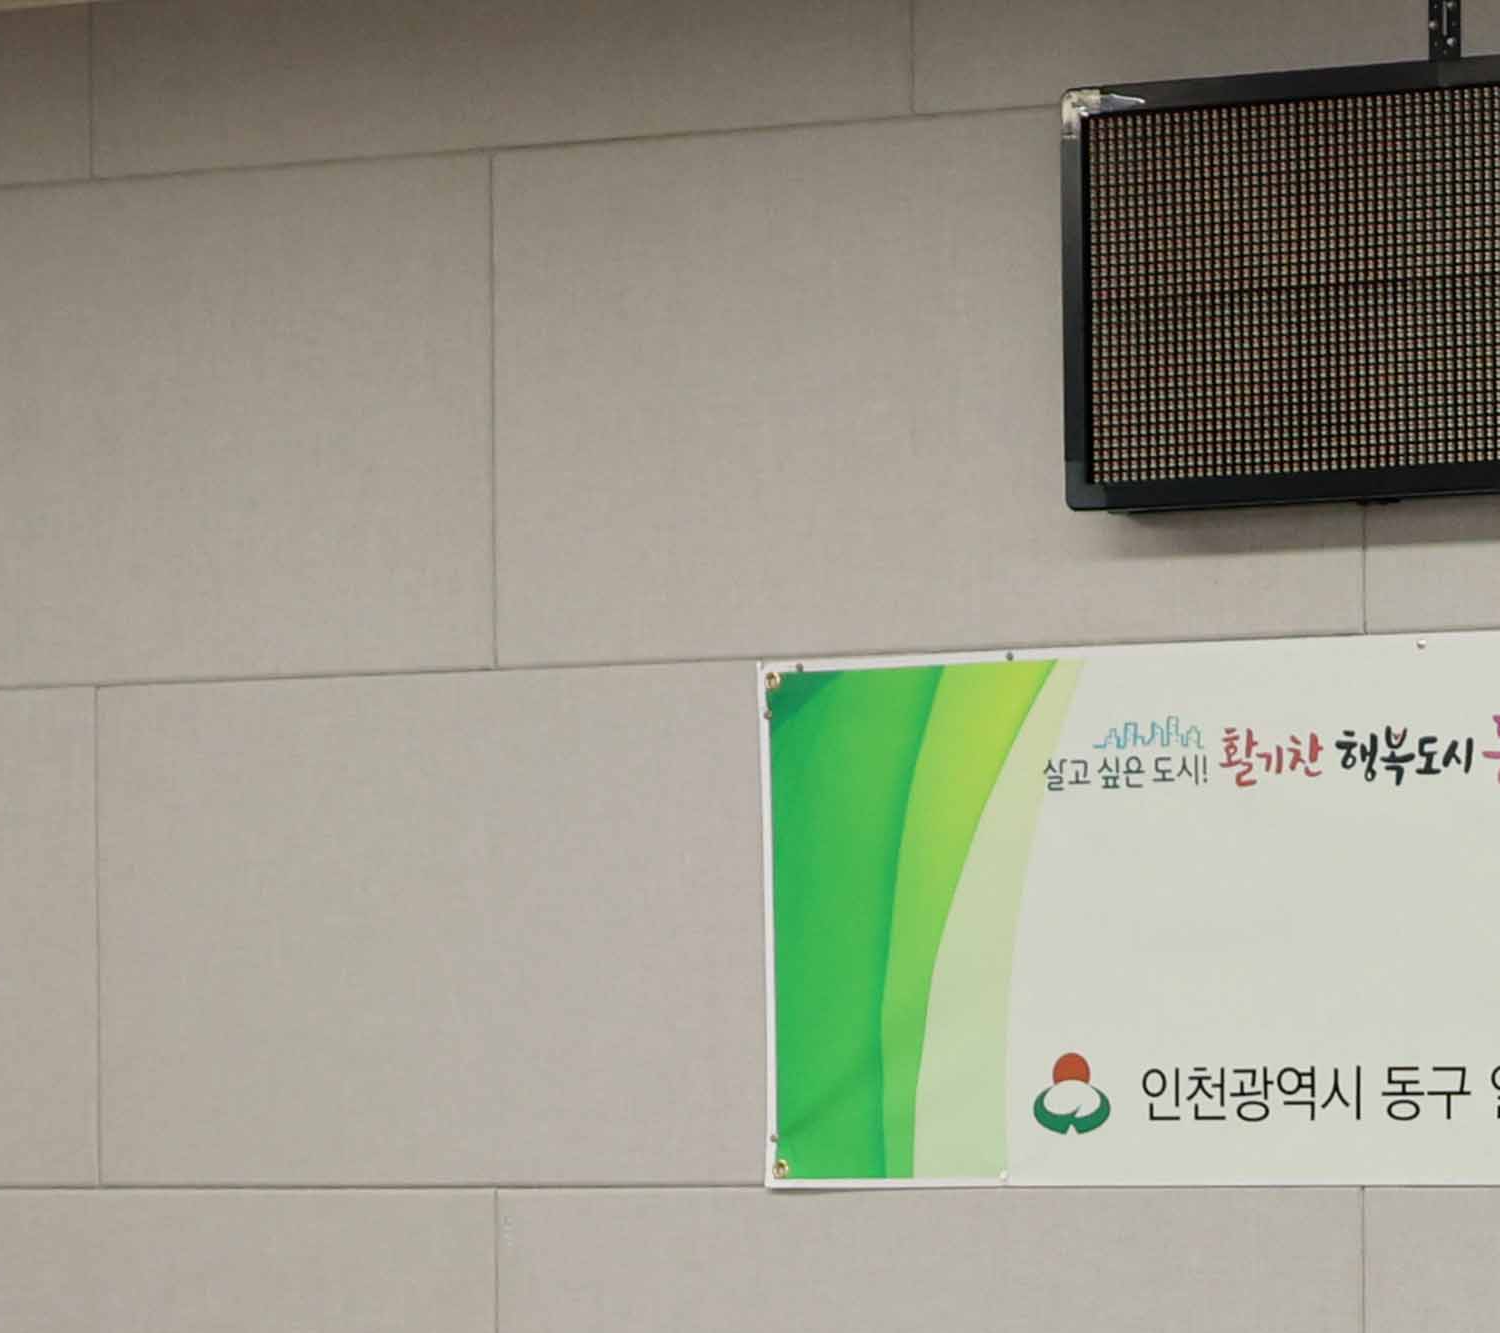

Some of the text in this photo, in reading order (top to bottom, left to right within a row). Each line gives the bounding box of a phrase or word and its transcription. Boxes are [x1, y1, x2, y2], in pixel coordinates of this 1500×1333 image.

[1043, 755, 1210, 793] 살고 싶은 도시!
[1218, 726, 1325, 789] 활기찬
[1334, 725, 1476, 788] 행복도시
[1140, 1064, 1364, 1125] 인천광역시
[1381, 1065, 1474, 1124] 동구
